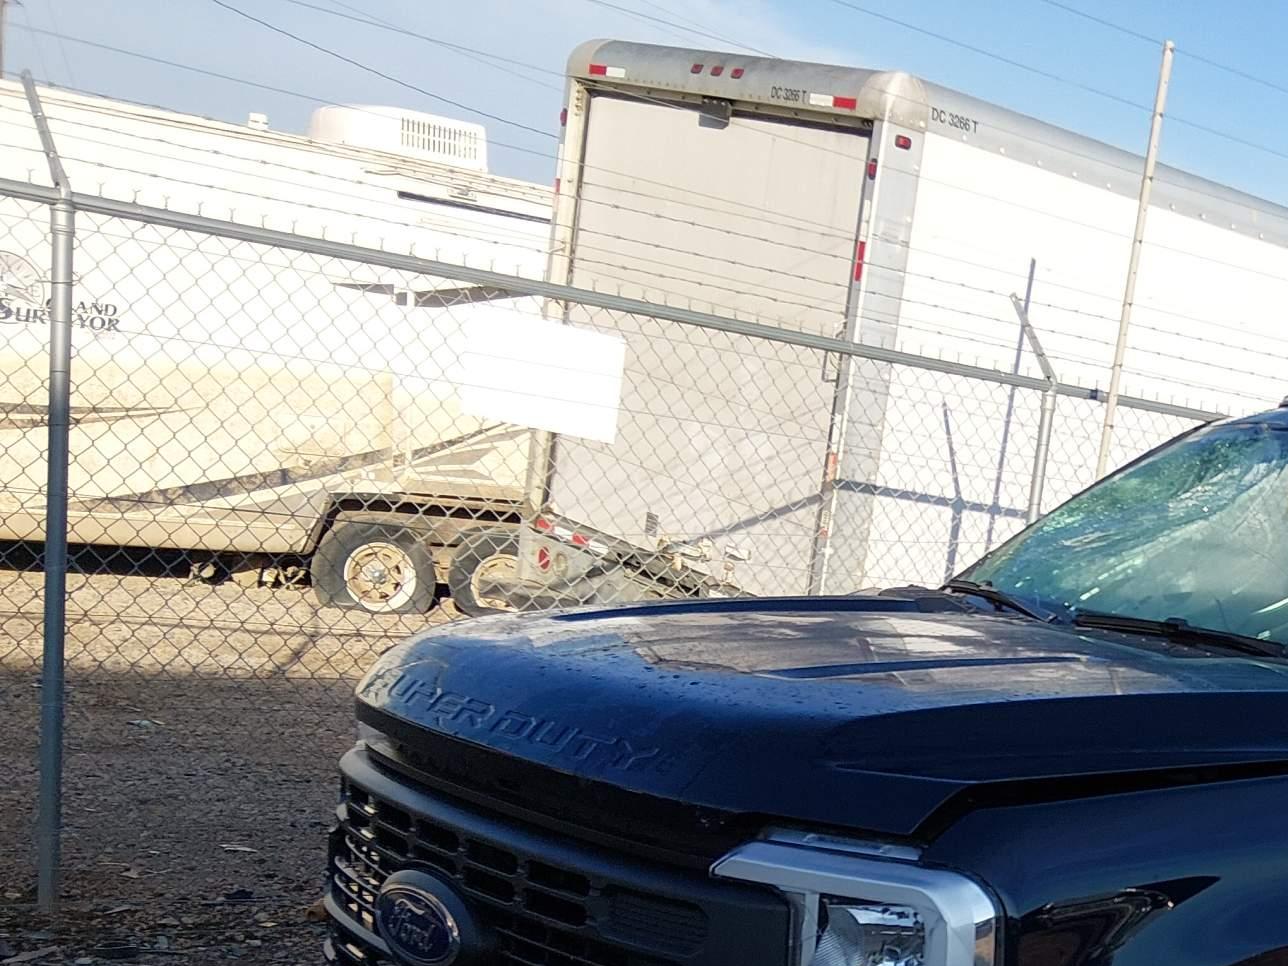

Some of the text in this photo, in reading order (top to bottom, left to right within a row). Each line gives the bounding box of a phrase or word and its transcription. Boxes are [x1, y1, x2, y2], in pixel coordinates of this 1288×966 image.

[931, 107, 979, 134] DC 3266 T
[0, 297, 121, 333] SURYOR
[489, 709, 661, 770] DUTY
